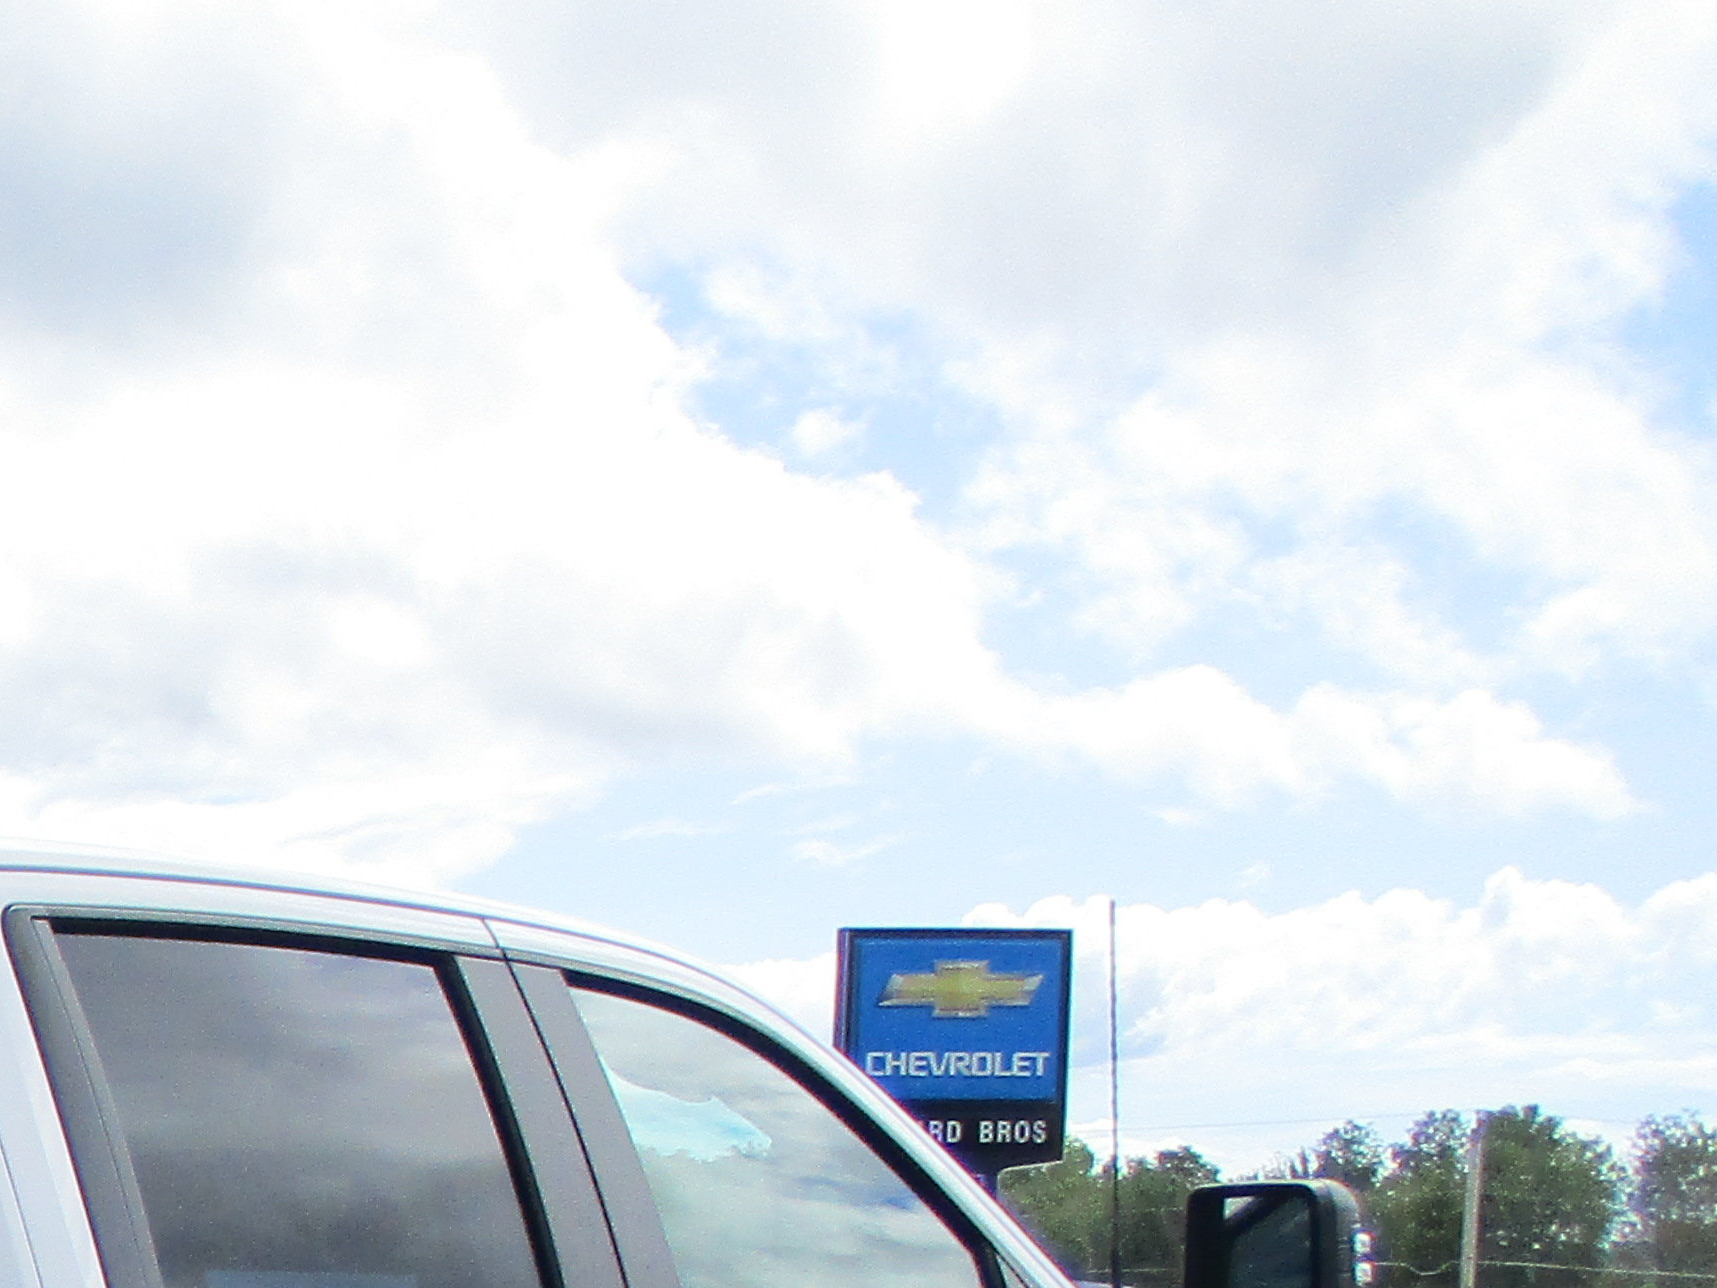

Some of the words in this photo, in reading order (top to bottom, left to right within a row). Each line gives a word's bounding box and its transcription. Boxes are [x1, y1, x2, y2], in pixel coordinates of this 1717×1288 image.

[866, 1052, 1050, 1077] CHEVROLET
[922, 1120, 962, 1144] RD
[979, 1120, 1048, 1144] BROS
